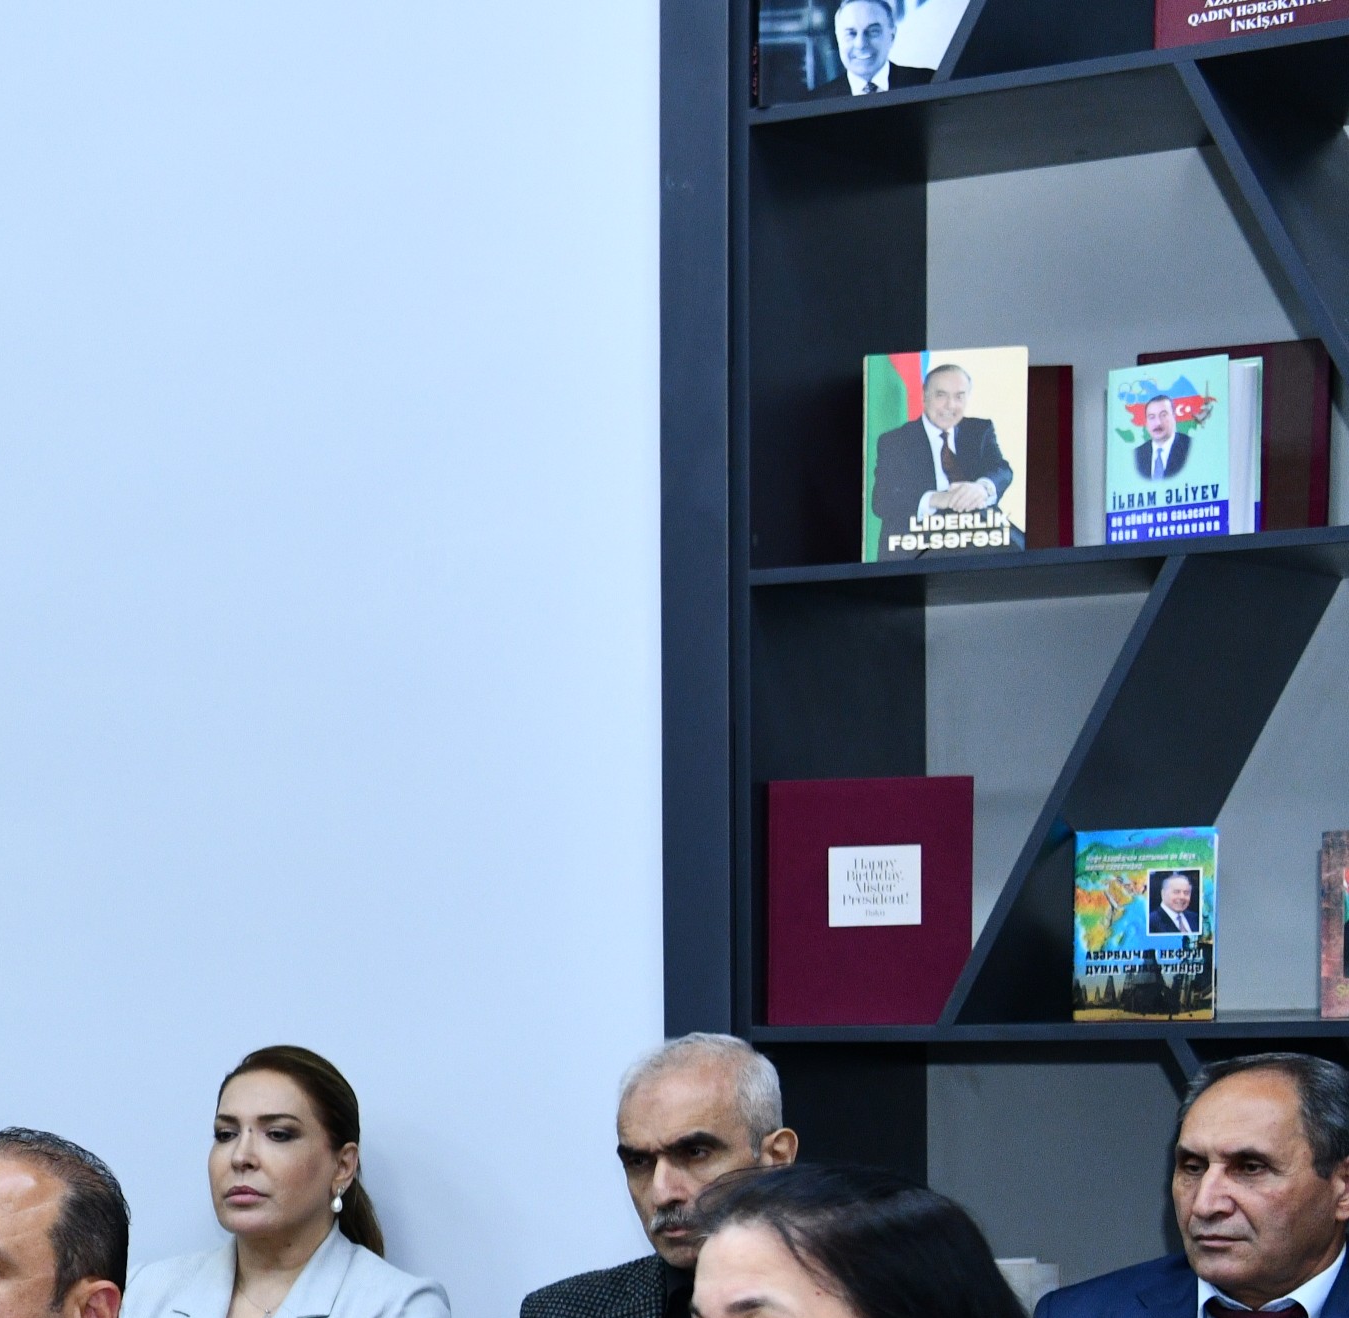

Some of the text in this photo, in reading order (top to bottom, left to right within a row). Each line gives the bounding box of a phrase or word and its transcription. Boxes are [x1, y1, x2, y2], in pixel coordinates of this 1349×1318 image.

[1187, 7, 1233, 27] QADIN
[1230, 11, 1295, 33] İNKİŞAFI
[1112, 483, 1219, 511] İLHAM ƏLİYEV
[909, 508, 1011, 532] LİDERLİK
[888, 526, 1011, 552] FƏLSƏFƏSİ
[854, 858, 897, 871] Happy
[843, 892, 908, 906] President!
